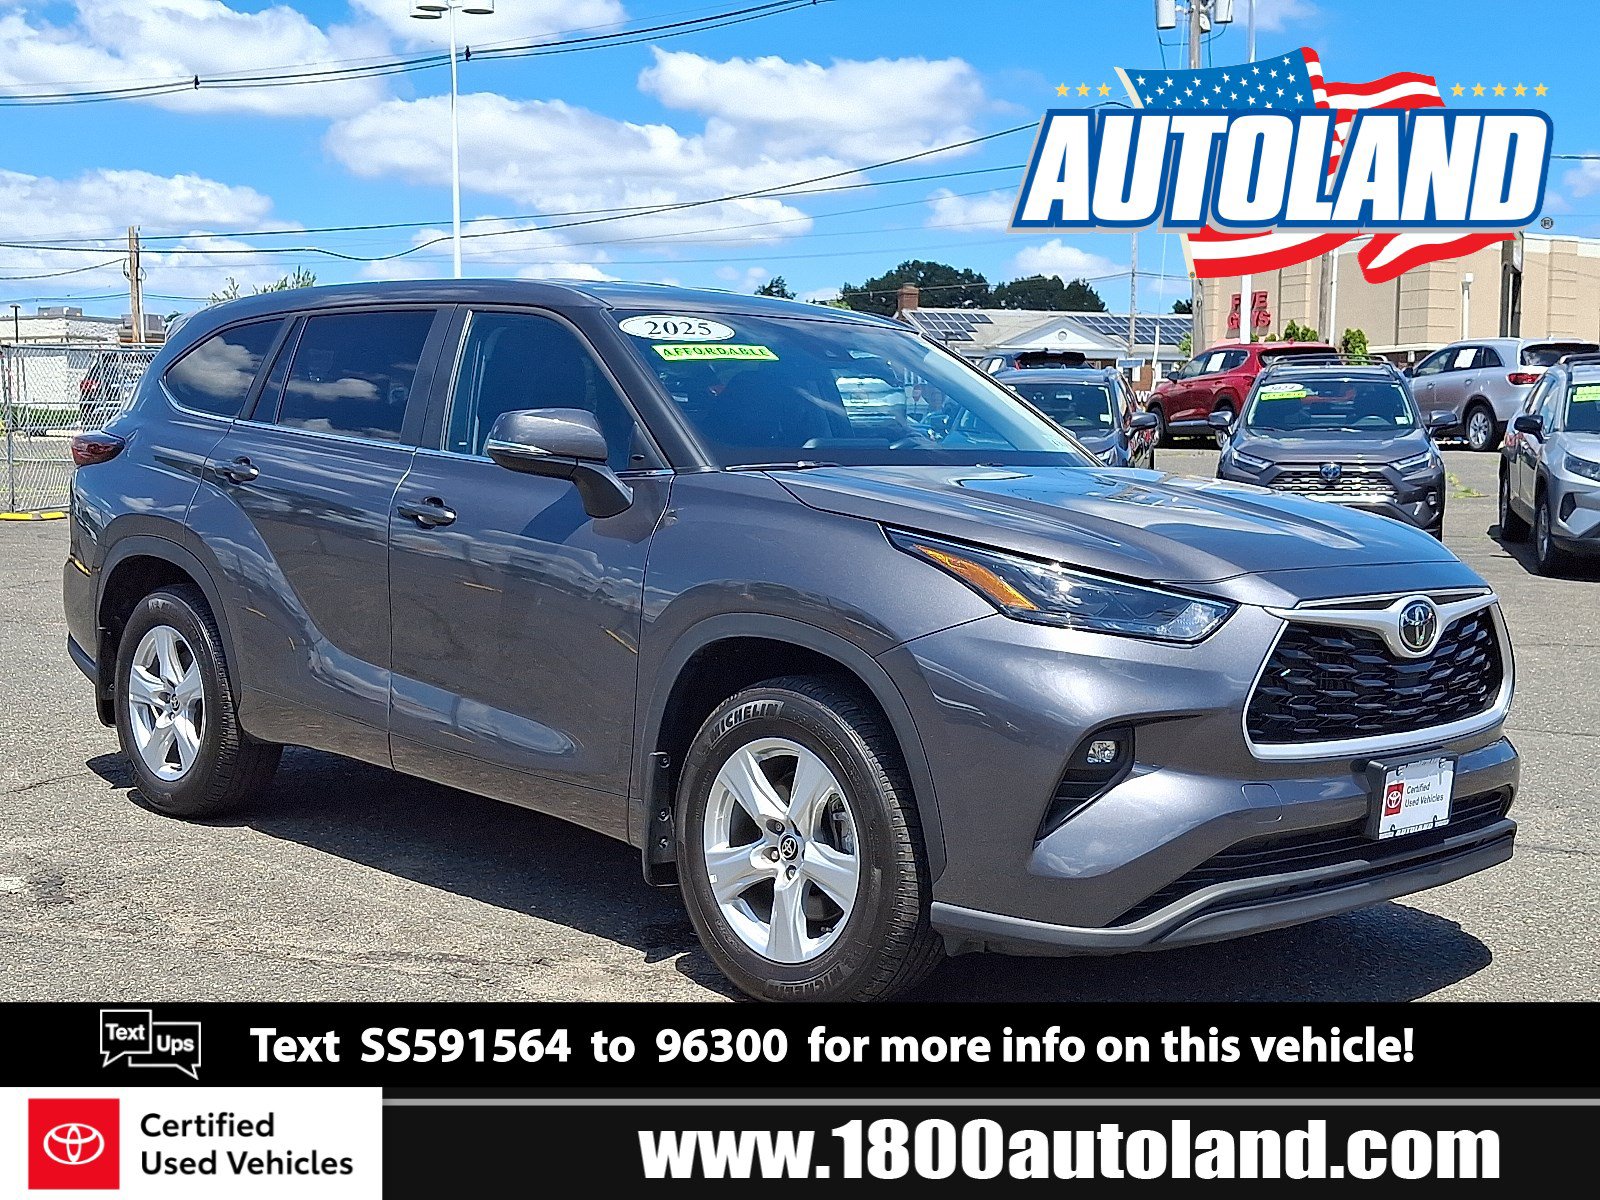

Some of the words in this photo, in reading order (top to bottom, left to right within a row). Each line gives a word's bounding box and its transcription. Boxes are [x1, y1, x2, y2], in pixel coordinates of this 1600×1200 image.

[1231, 291, 1268, 308] FE
[644, 321, 712, 335] 2025
[663, 347, 770, 357] AFFORDABLE
[709, 700, 784, 743] MICHELIN
[1407, 783, 1430, 795] Certified
[1405, 798, 1420, 808] Used
[1421, 794, 1443, 805] Vehicles
